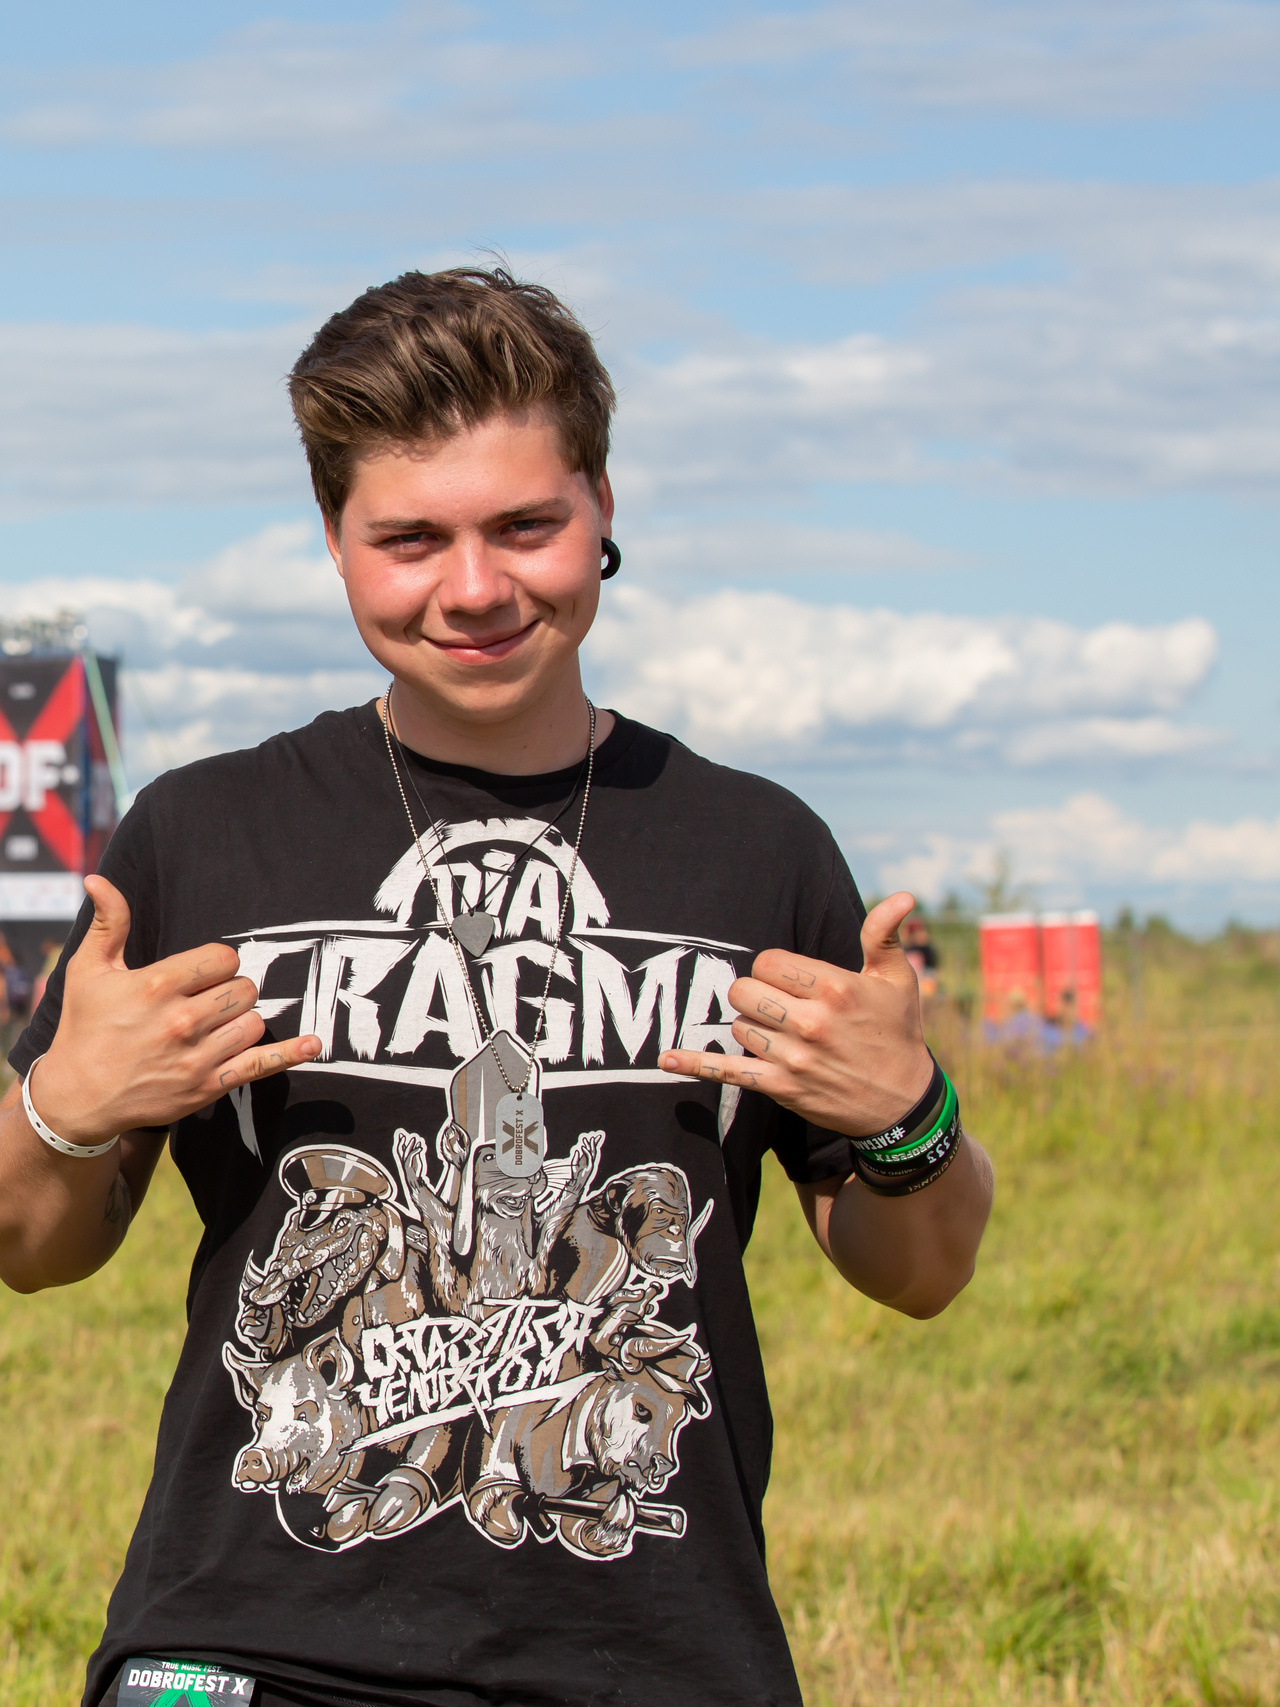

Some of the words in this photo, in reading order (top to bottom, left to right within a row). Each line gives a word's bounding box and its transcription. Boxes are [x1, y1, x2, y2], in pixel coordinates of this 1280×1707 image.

[515, 1118, 524, 1165] DOBROFEST
[883, 1127, 944, 1162] DOBROFEST
[127, 1669, 230, 1693] DOBROFEST
[231, 1677, 249, 1696] X
[161, 1661, 179, 1670] TRUE
[181, 1663, 202, 1672] MUSIC
[203, 1665, 222, 1673] FEST
